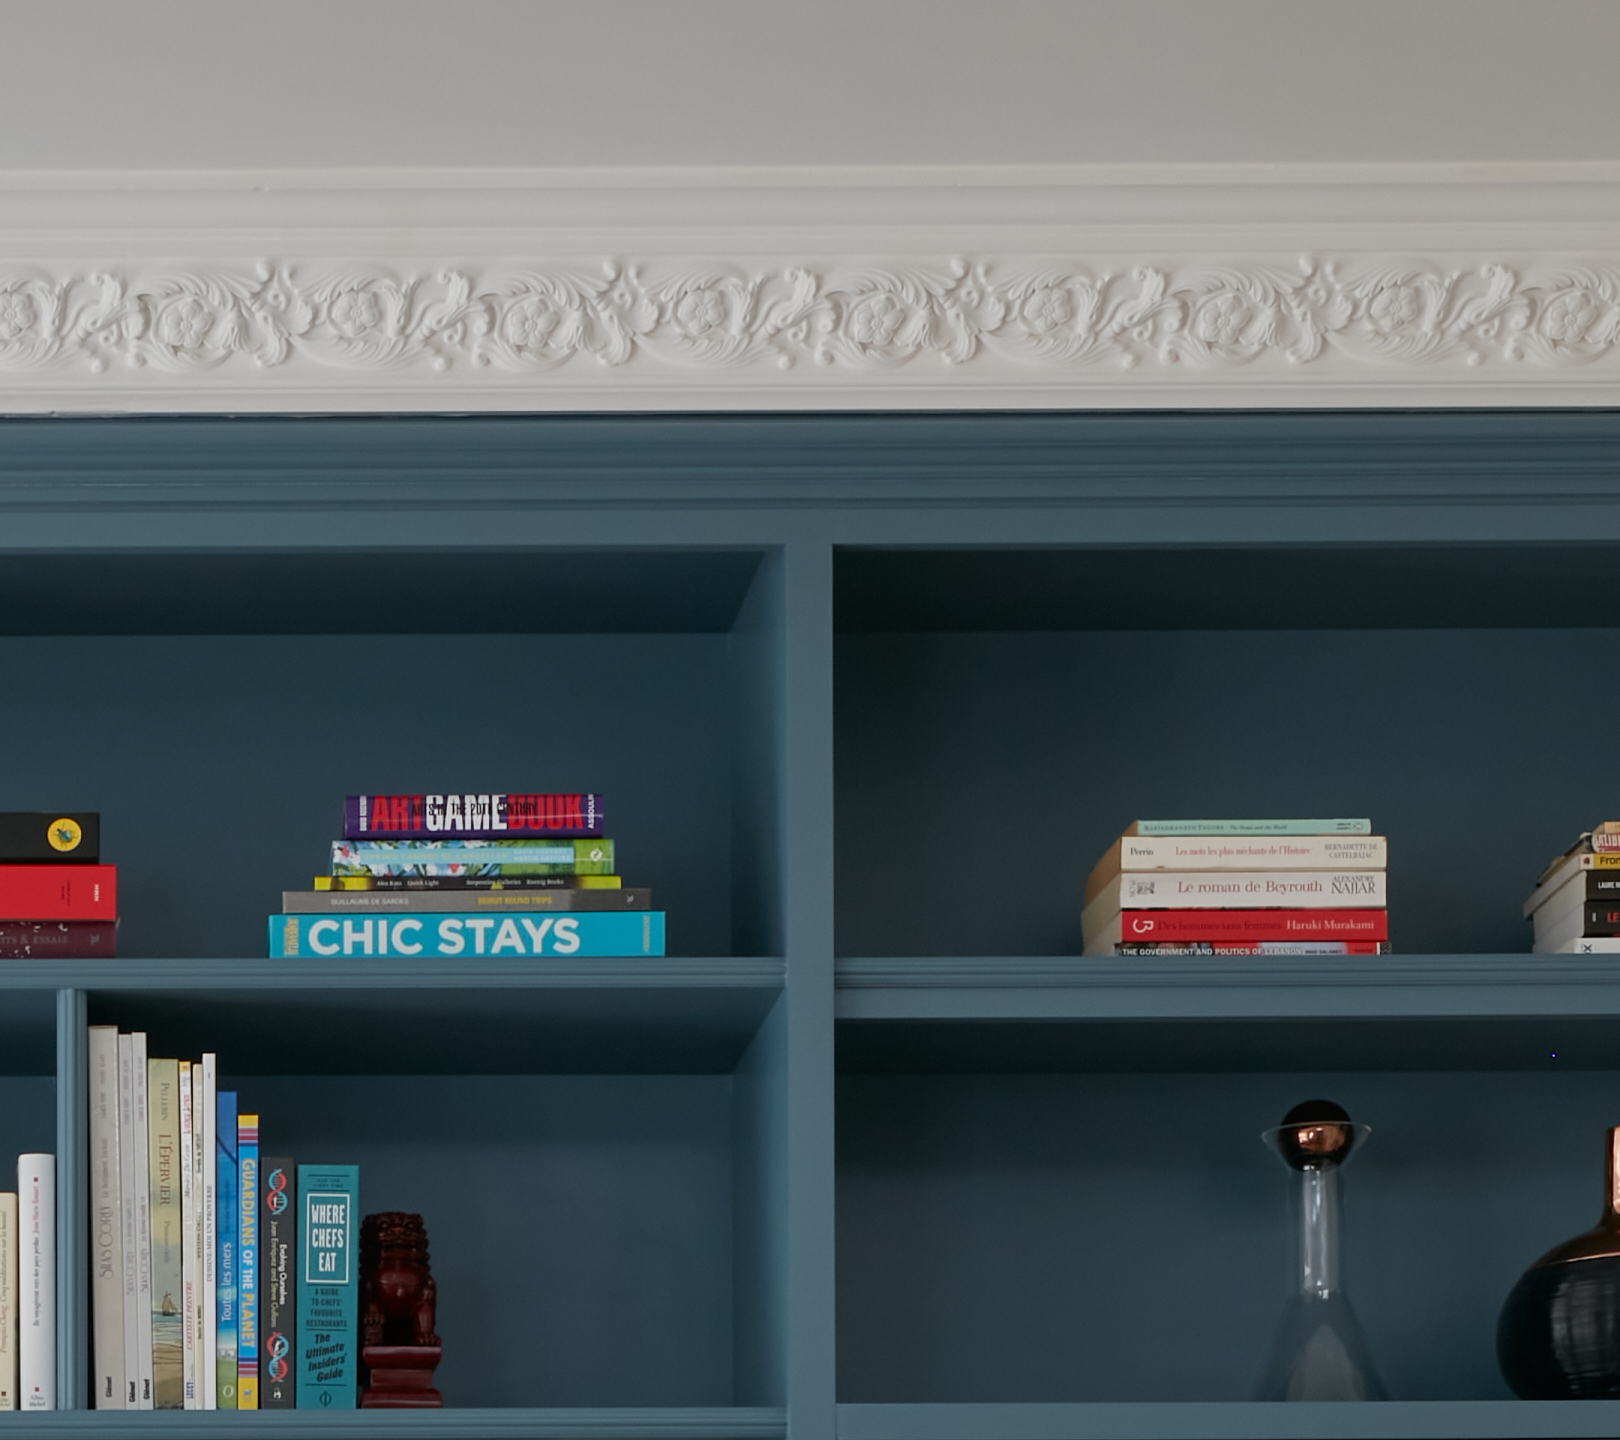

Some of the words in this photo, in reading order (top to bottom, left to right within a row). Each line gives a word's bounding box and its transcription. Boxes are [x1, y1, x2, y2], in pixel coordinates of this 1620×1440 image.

[1178, 882, 1193, 893] Le
[1198, 884, 1240, 893] roman
[1245, 882, 1260, 893] de
[1265, 881, 1322, 895] Beyrouth
[1287, 920, 1321, 930] Haruki
[1324, 920, 1374, 930] Murakami
[1607, 912, 1619, 922] LE
[308, 919, 423, 955] CHIC
[437, 919, 581, 955] STAYS
[241, 1158, 255, 1246] GUARDIANS
[311, 1204, 345, 1225] WHERE
[312, 1228, 344, 1249] CHEFS
[242, 1250, 254, 1266] OF
[318, 1252, 336, 1272] EAT
[242, 1268, 254, 1290] THE
[241, 1293, 255, 1348] PLANET
